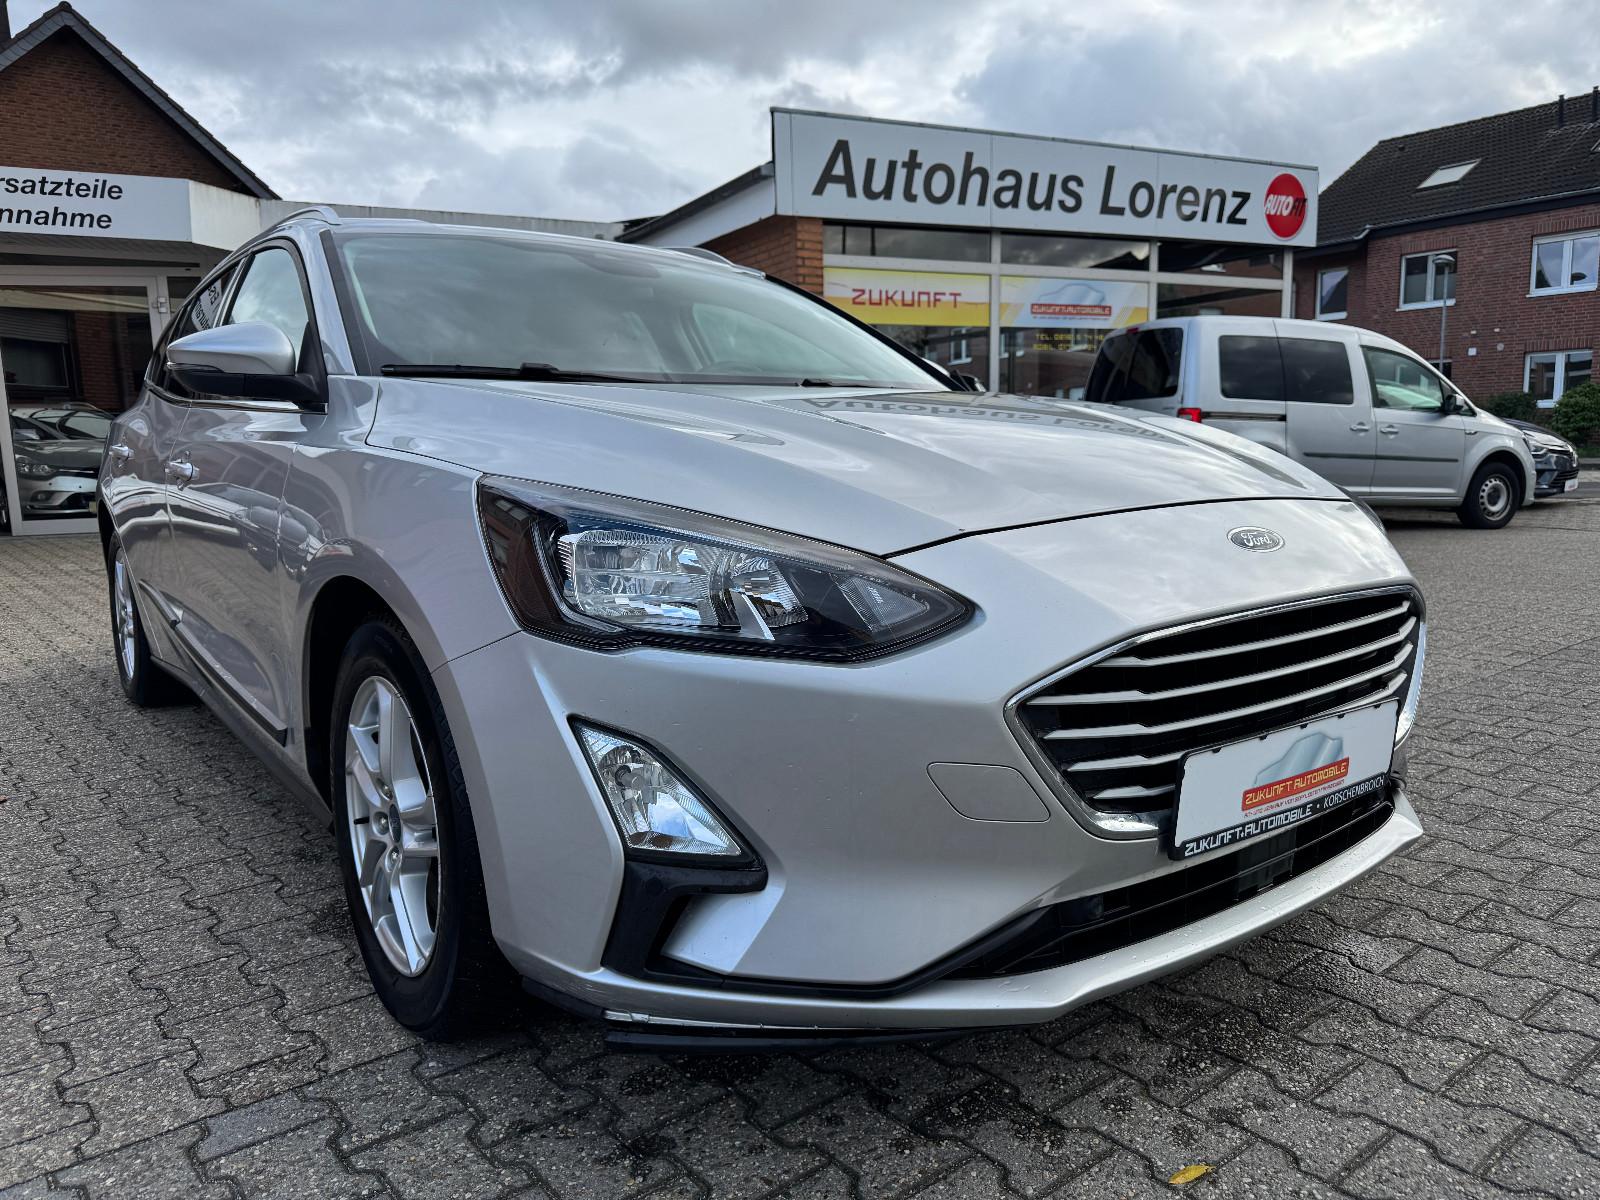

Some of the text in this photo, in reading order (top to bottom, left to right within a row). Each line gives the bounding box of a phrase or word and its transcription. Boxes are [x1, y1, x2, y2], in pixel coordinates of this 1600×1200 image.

[812, 139, 1252, 225] Autohaus Lorenz
[851, 288, 962, 308] ZUKUNFT
[1240, 532, 1273, 547] Ford
[1323, 775, 1385, 809] KORSCHENBROICH
